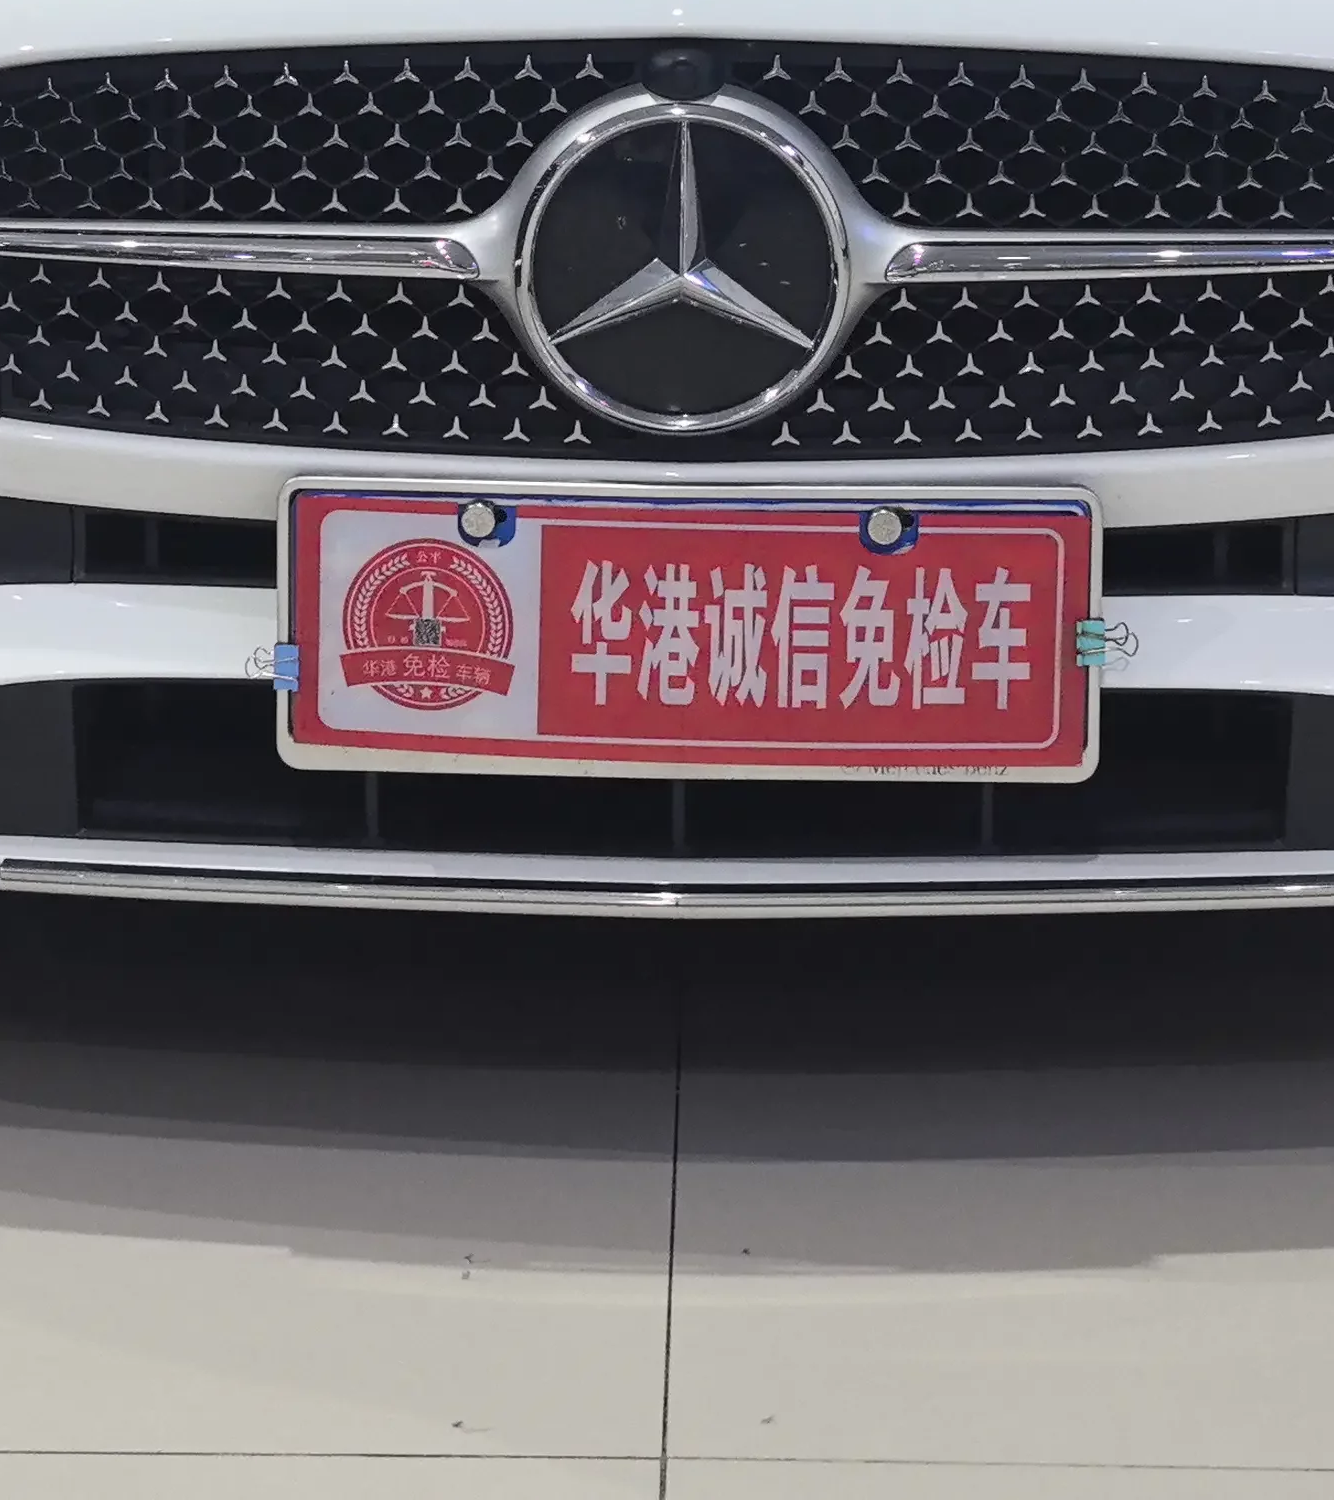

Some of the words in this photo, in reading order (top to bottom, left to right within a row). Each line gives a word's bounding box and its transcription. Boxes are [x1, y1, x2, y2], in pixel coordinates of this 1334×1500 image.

[402, 652, 451, 679] 免检
[570, 559, 1032, 710] 华港诚信免检车
